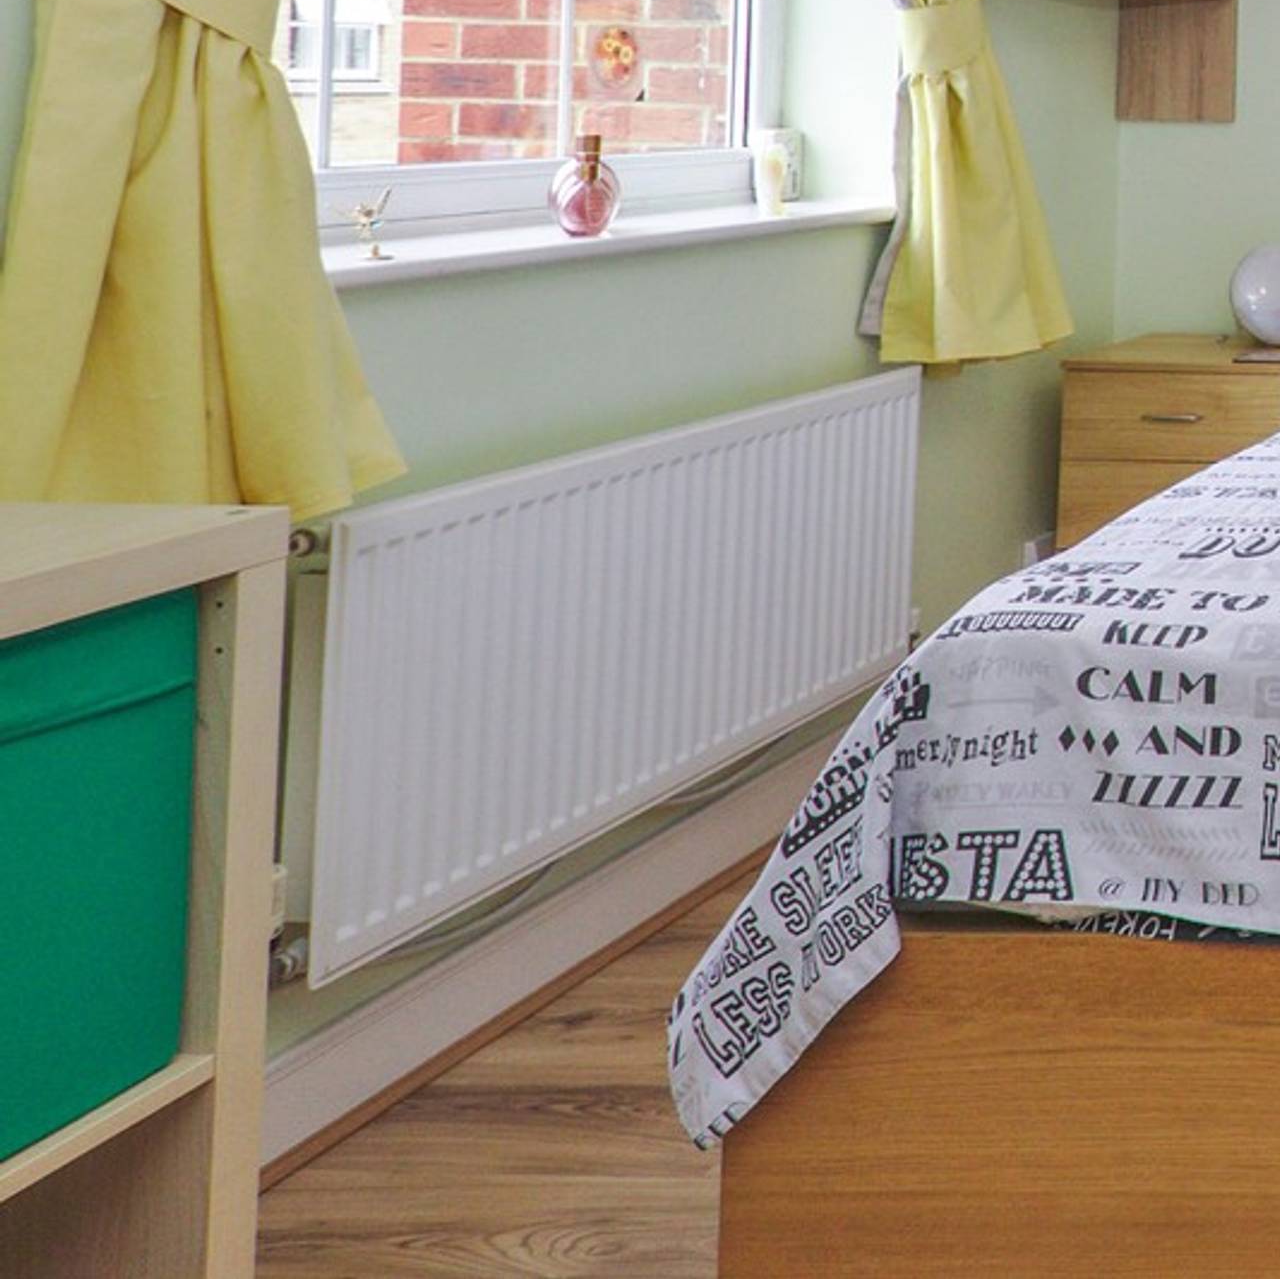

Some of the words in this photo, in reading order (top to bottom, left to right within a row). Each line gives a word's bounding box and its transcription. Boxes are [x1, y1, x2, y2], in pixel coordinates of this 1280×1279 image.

[1009, 584, 1176, 612] MADE
[1189, 590, 1269, 613] TO
[1102, 619, 1209, 650] KEEP
[1076, 666, 1217, 705] CALM
[962, 726, 1040, 767] night
[1136, 725, 1242, 757] AND
[692, 960, 797, 1079] LESS
